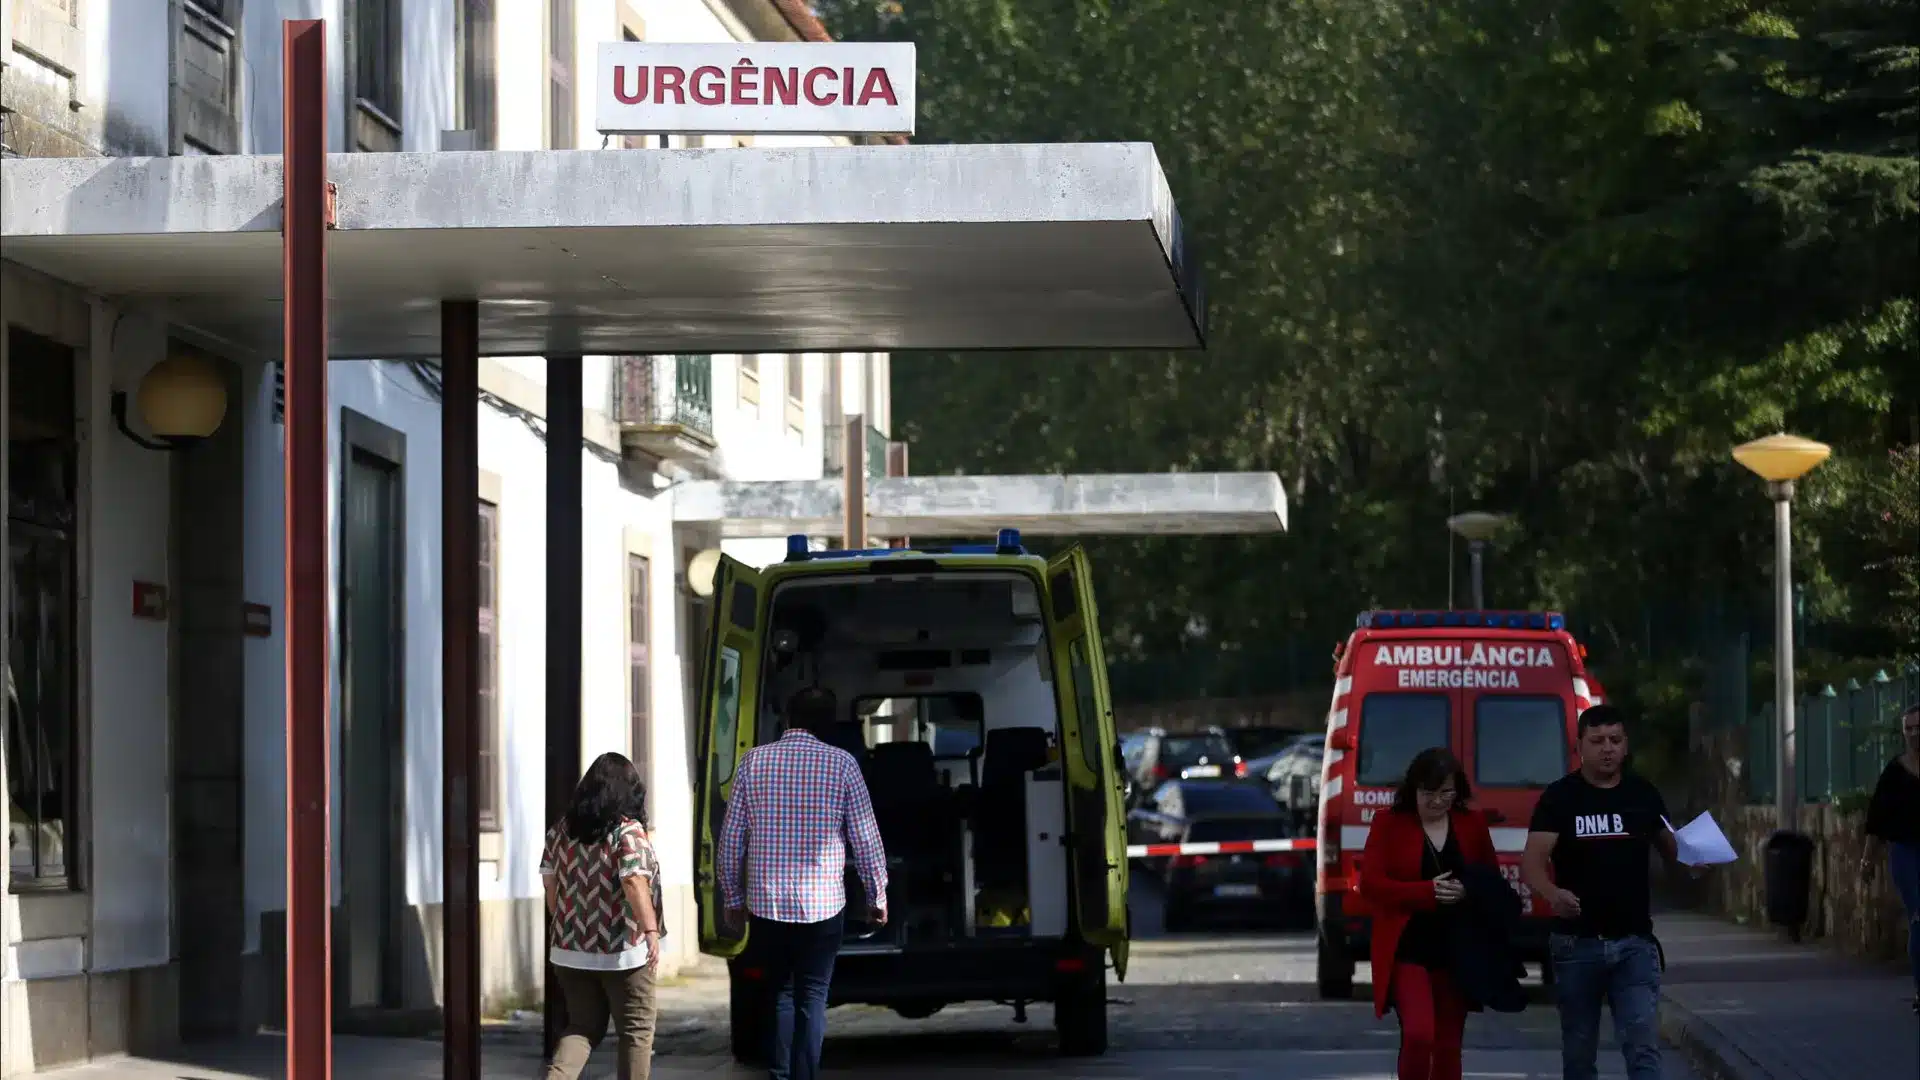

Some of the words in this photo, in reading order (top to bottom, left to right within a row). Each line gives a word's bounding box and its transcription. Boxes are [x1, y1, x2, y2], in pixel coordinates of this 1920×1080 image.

[613, 57, 898, 106] URGÊNCIA
[1374, 643, 1554, 667] AMBULÂNCIA
[1398, 667, 1520, 689] EMERGÊNCIA
[1575, 814, 1609, 835] DNM
[1612, 813, 1624, 833] B
